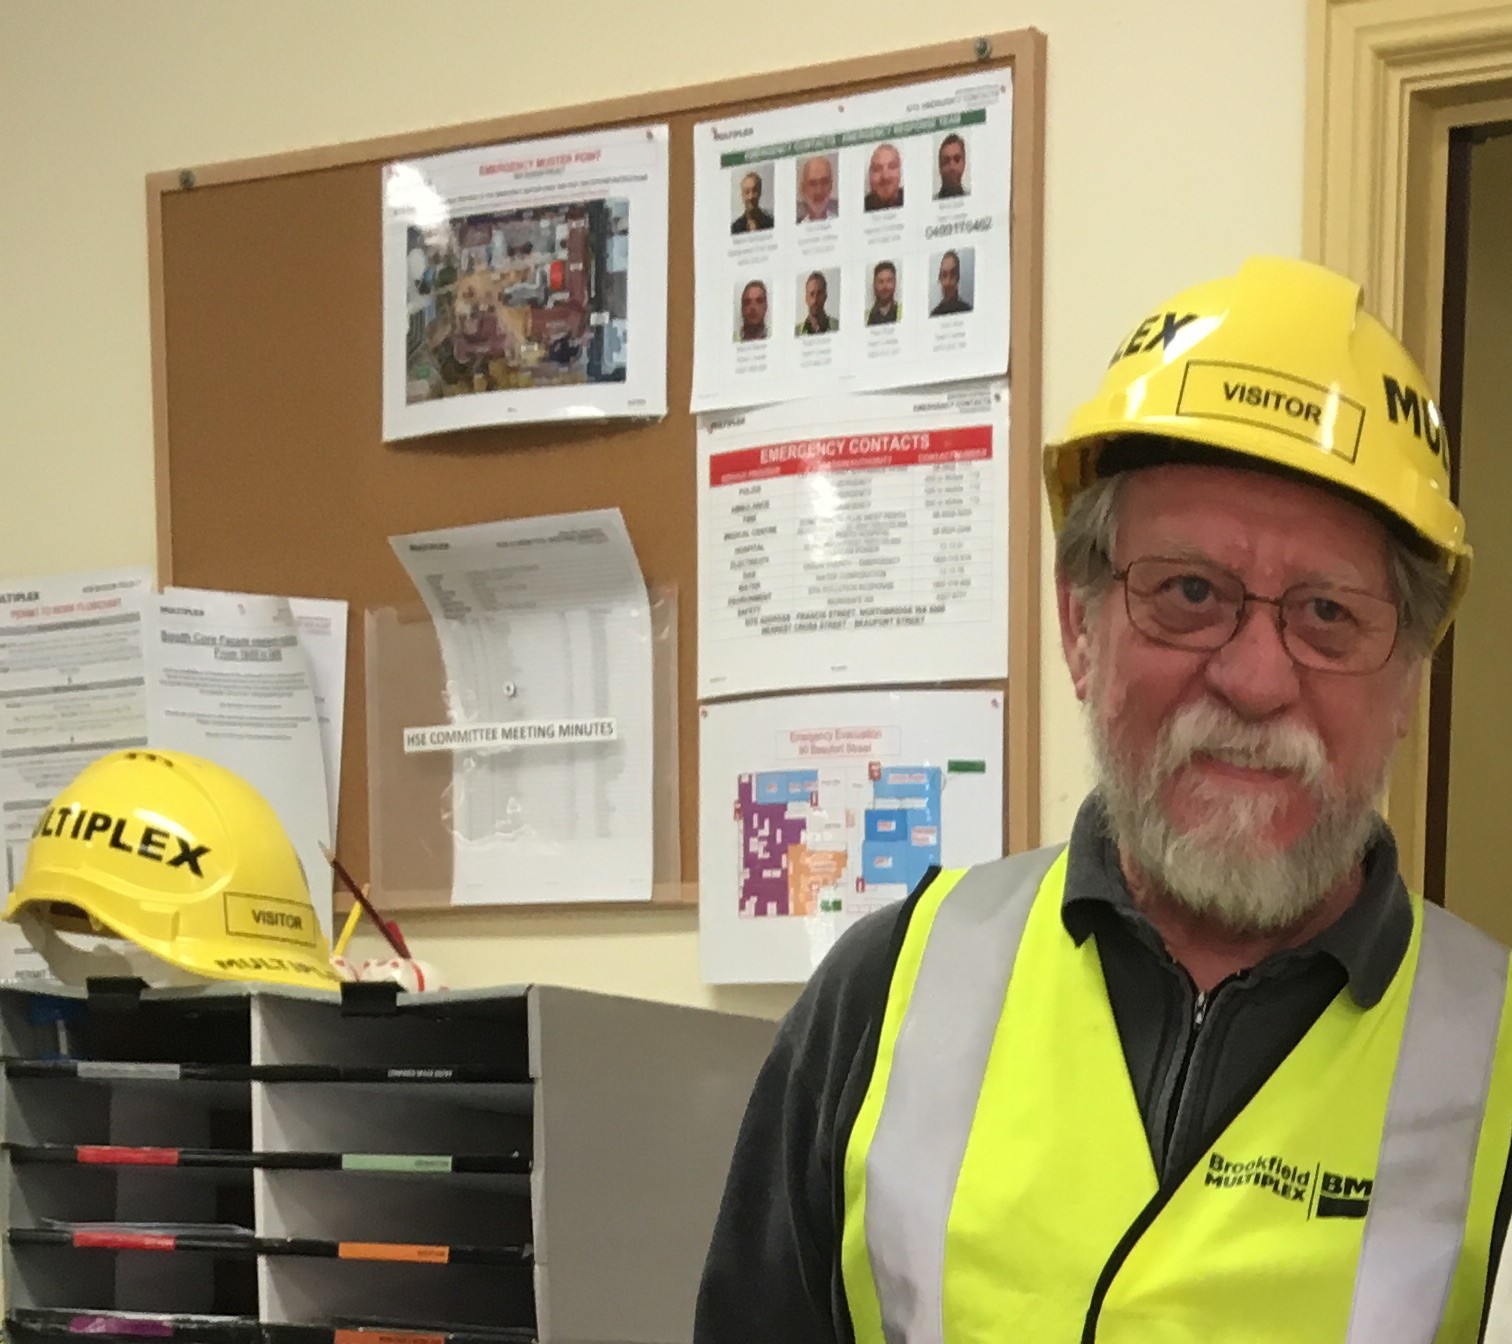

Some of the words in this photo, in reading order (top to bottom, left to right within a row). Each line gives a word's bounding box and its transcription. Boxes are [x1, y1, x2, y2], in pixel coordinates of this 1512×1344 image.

[1222, 379, 1322, 426] VISITOR
[760, 437, 846, 464] EMERGENCY
[849, 433, 930, 455] CONTACTS
[406, 733, 427, 747] HSE
[429, 728, 498, 746] COMMITTEE
[500, 724, 556, 742] MEETING
[558, 720, 614, 738] MINUTES
[251, 908, 304, 931] VISITOR
[1208, 1151, 1311, 1187] Brookfield
[1204, 1170, 1307, 1203] MULTIPLEX
